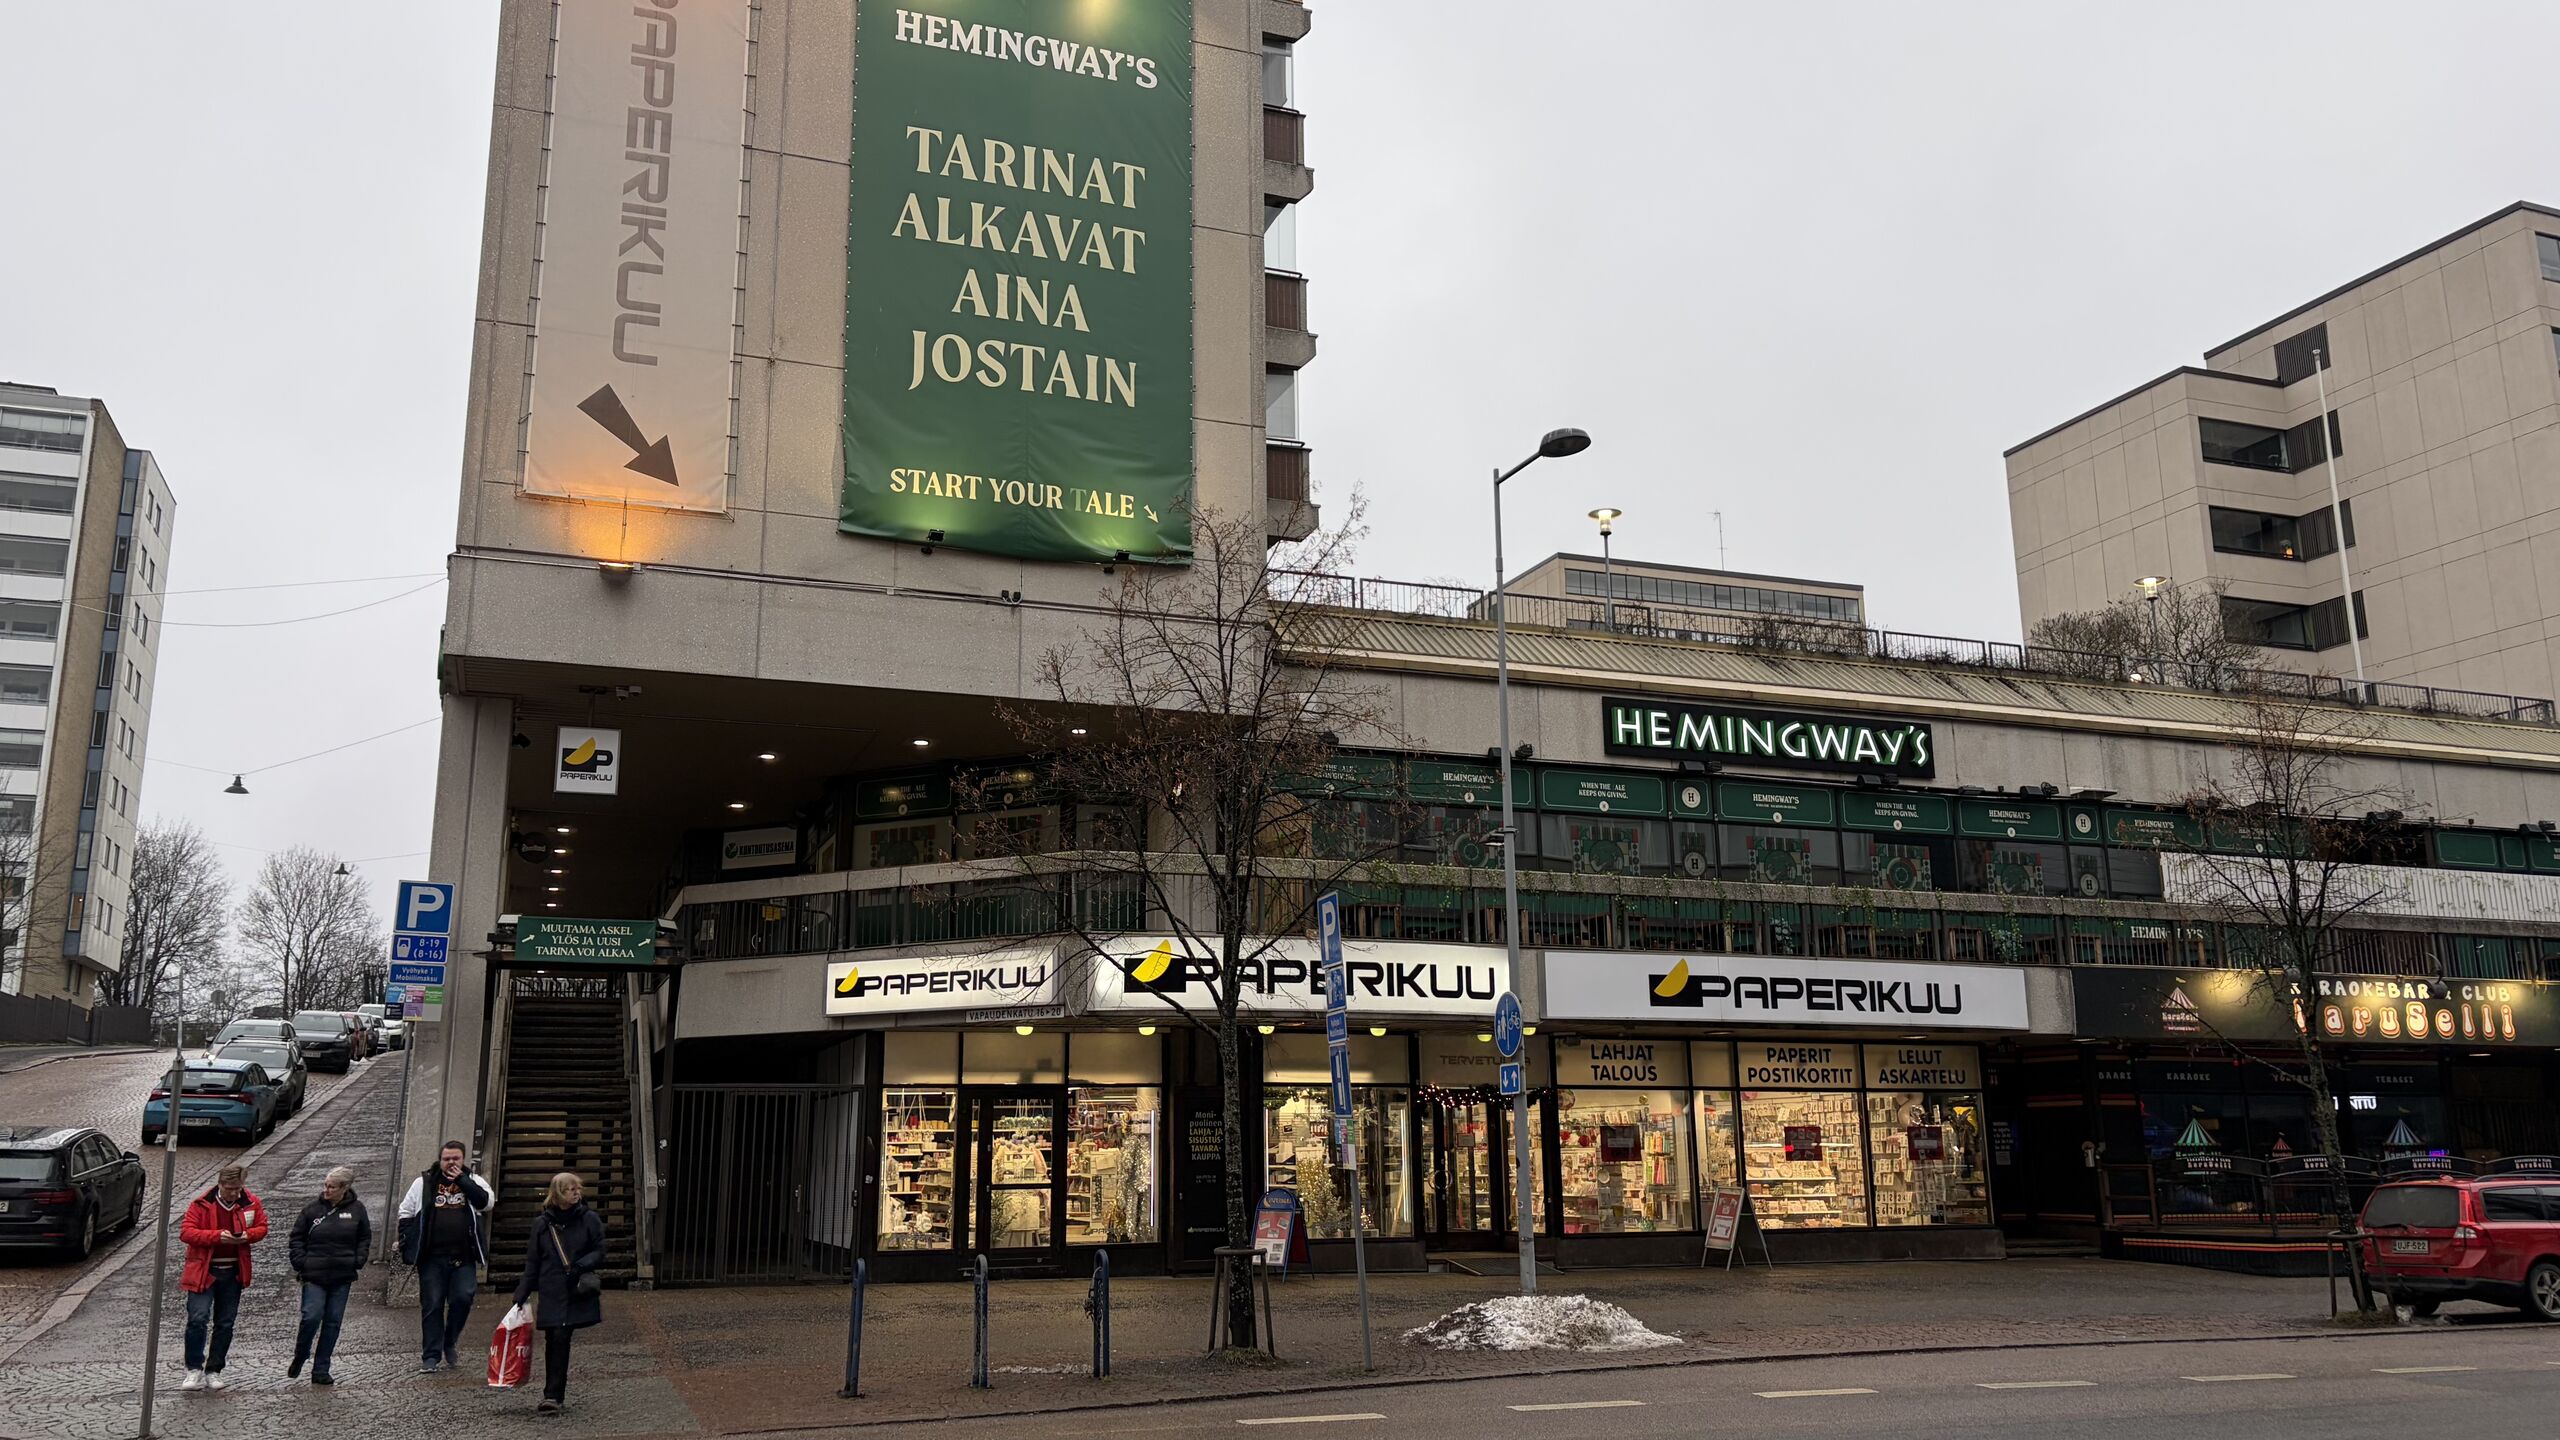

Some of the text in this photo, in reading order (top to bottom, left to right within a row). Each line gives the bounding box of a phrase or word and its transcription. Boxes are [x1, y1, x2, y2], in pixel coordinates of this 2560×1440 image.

[895, 9, 1159, 89] HEMINGWAY'S
[905, 126, 1146, 209] TARINAT
[613, 0, 679, 366] APERIKUU
[892, 192, 1146, 275] ALKAVAT
[951, 269, 1090, 333] AINA
[908, 330, 1137, 408] JOSTAIN
[890, 468, 1135, 520] START YOUR TALE
[1611, 706, 1930, 767] HEMINGWAY'S
[560, 772, 613, 781] PAPERIKUU
[1581, 781, 1599, 789] WHEN
[1579, 789, 1597, 797] KEEPS
[1607, 791, 1628, 799] GIVING.
[1752, 793, 1800, 804] HEMINGWAY'S
[1875, 808, 1891, 816] KEEPS
[1876, 801, 1892, 809] WHEN
[1988, 809, 2031, 820] HEMINGWAY'S
[407, 886, 445, 929] P
[540, 923, 633, 936] MUUTAMA ASKEL
[1321, 901, 1336, 961] P
[2130, 926, 2204, 940] HEMINY'S
[419, 938, 440, 948] 8-19
[551, 933, 621, 946] YLÖS JA UUSI
[413, 949, 443, 960] (8-16)
[535, 946, 635, 958] TARINA VOI ALKAA
[860, 964, 1046, 996] PAPERIKUU
[1694, 975, 1962, 1015] PAPERIKUU
[2289, 979, 2429, 1000] KRAOKEBAR
[2461, 985, 2512, 1001] CLUB
[969, 1007, 1034, 1021] VAPAUDENKATU
[1591, 1044, 1654, 1061] LAHJAT
[1767, 1047, 1831, 1064] PAPERIT
[1898, 1049, 1943, 1065] LELUT
[1440, 1055, 1531, 1065] TERVETUA
[1591, 1064, 1658, 1082] TALOUS
[1747, 1067, 1853, 1084] POSTIKORTIT
[1879, 1068, 1966, 1084] ASKARTELU
[2166, 1072, 2211, 1081] KARAOKE
[1195, 1111, 1217, 1119] Moni-
[1189, 1120, 1223, 1128] puolinen
[1215, 1128, 1223, 1136] JA
[1188, 1136, 1223, 1144] SISUSTUS-
[2397, 1241, 2426, 1250] UJF-522
